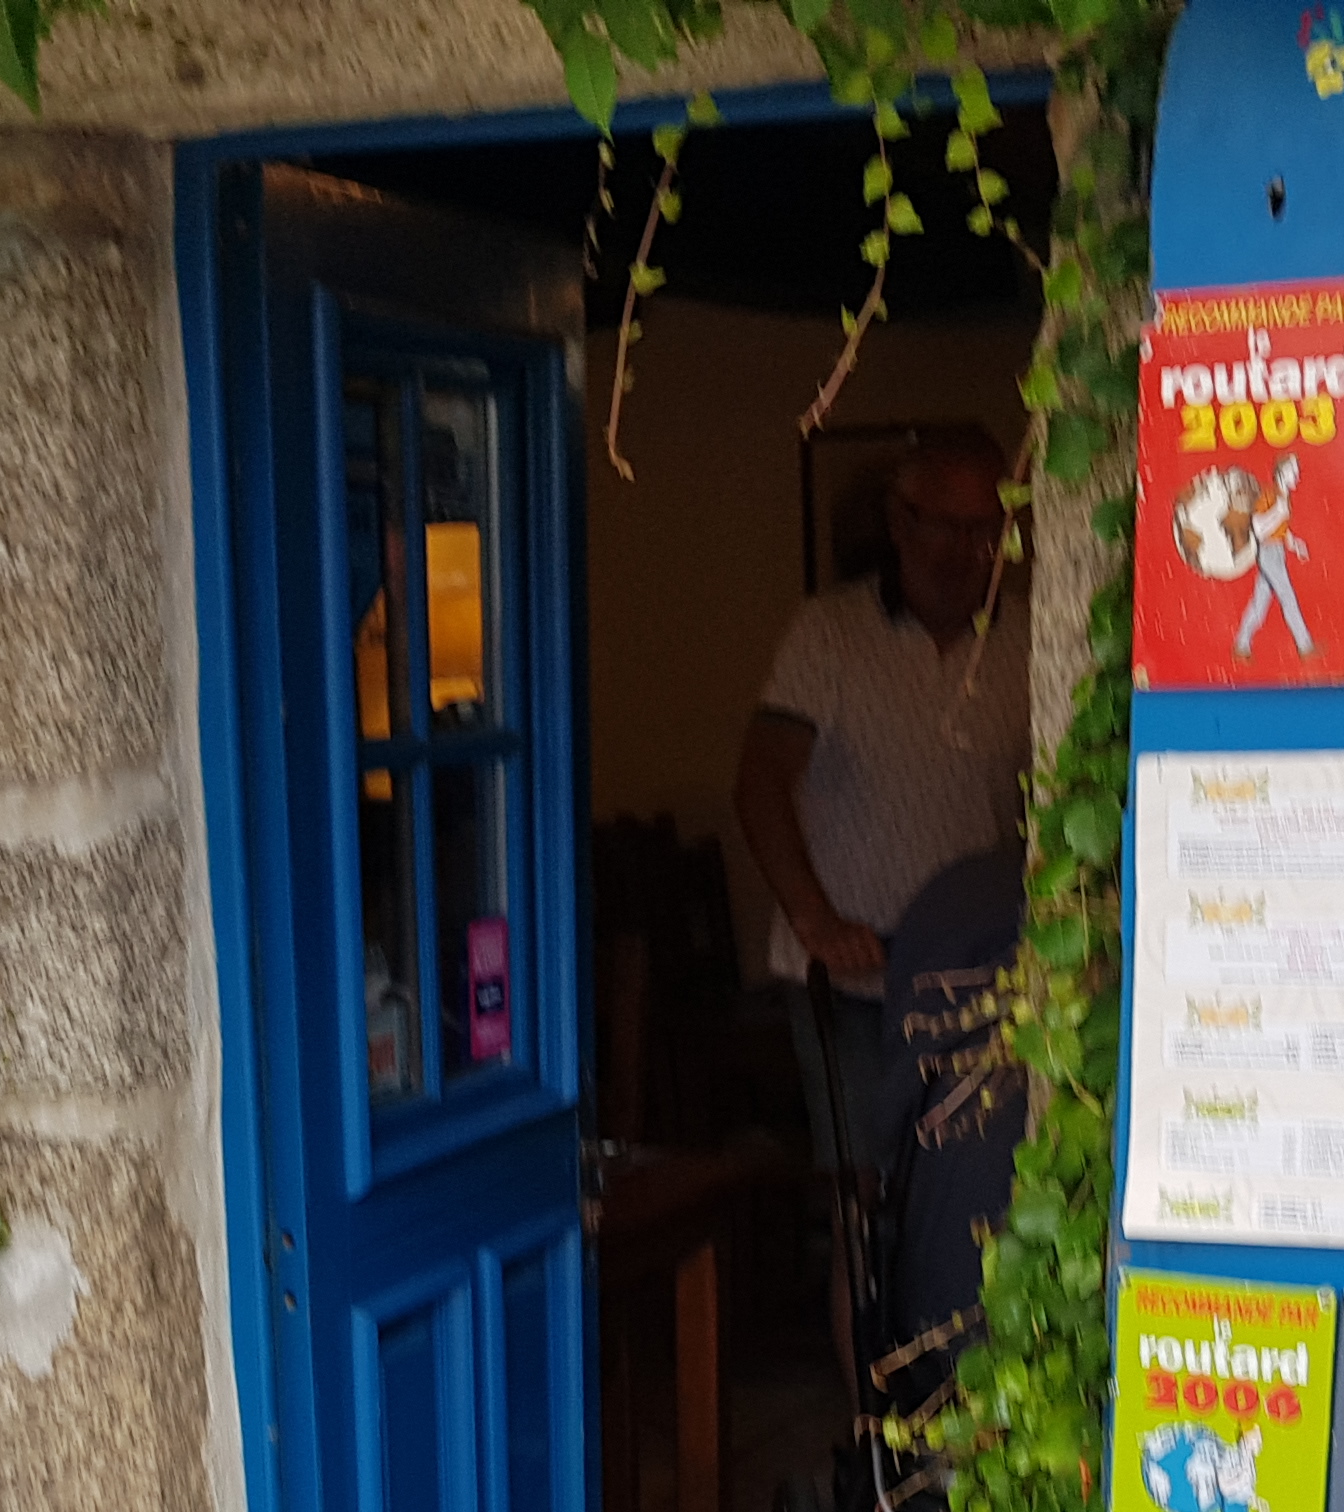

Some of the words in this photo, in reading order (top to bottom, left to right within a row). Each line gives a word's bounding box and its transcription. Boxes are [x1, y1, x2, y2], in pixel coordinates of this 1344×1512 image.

[1178, 391, 1336, 452] 2003
[1139, 1333, 1309, 1386] routard
[1146, 1367, 1302, 1425] 2006
